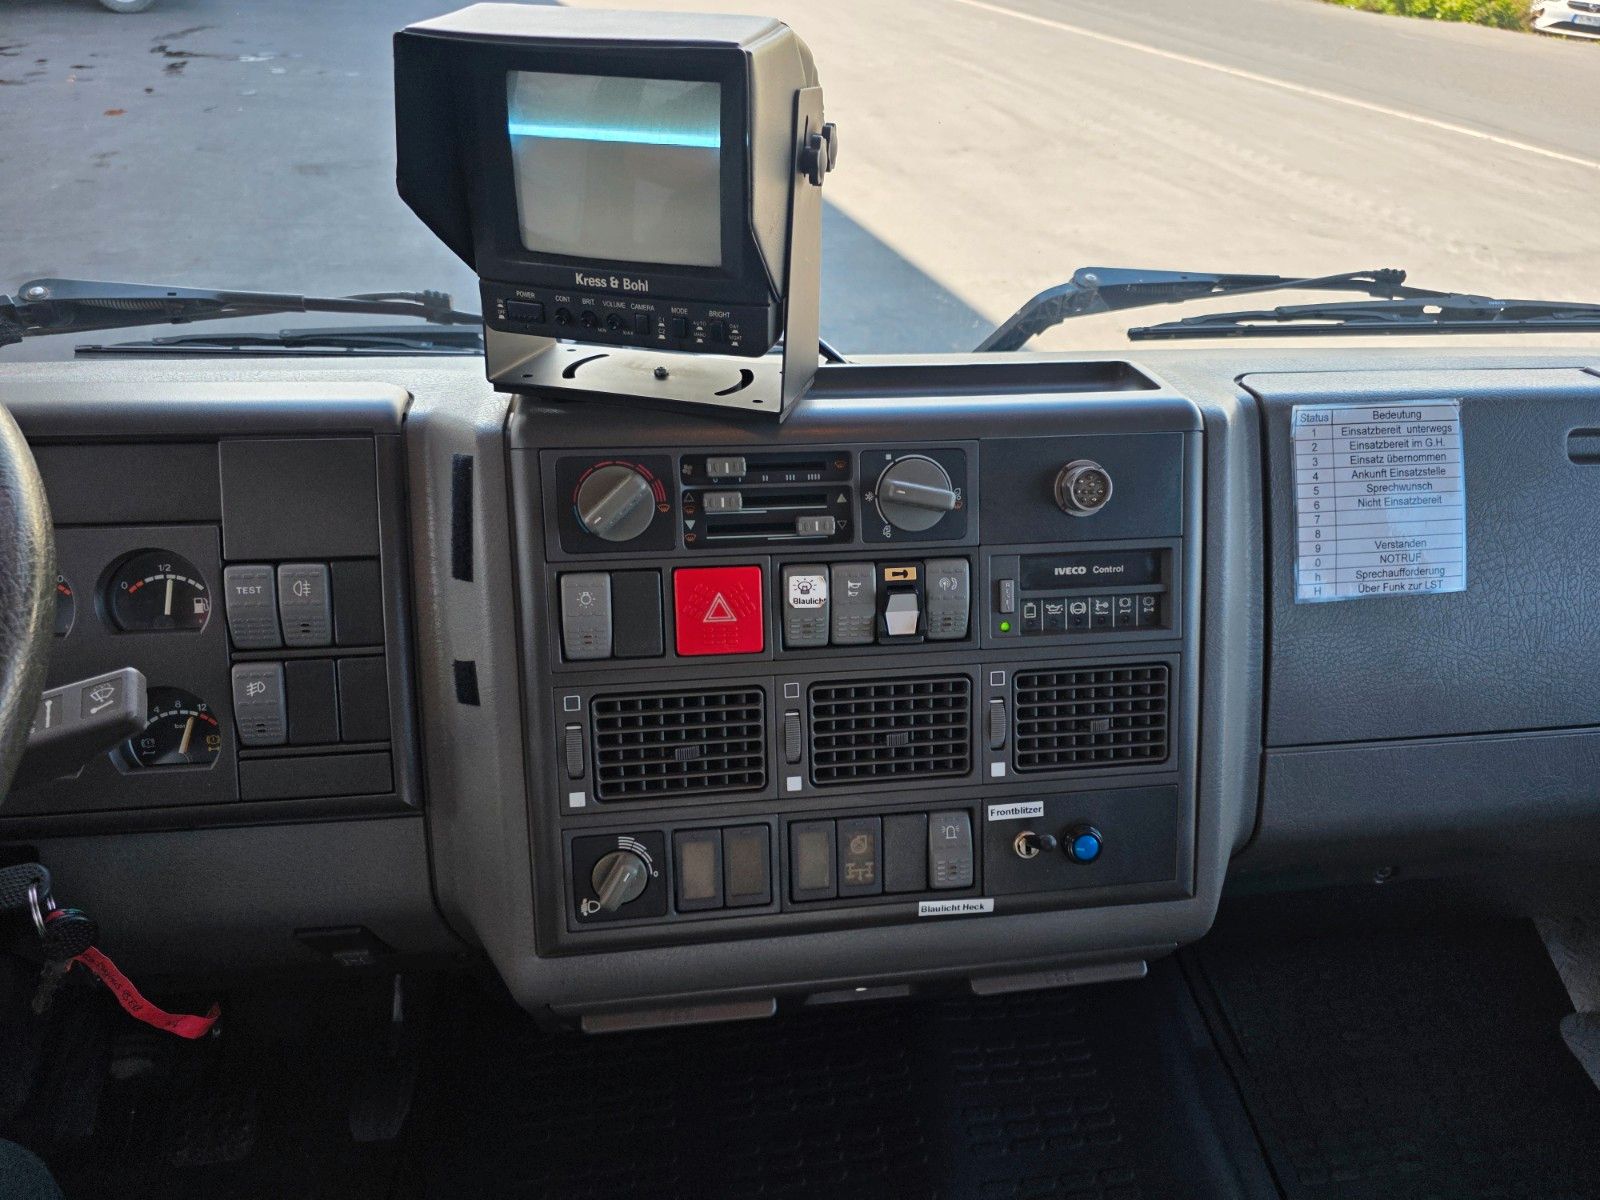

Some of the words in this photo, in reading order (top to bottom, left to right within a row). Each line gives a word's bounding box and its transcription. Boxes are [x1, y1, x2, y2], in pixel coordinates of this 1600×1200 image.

[575, 272, 607, 288] Kress
[609, 276, 619, 289] &
[622, 278, 649, 292] Bohl
[516, 290, 535, 299] POWER
[602, 300, 626, 309] VOLUME
[630, 303, 655, 312] CAMERA
[671, 307, 688, 315] MODE
[708, 310, 731, 319] BRIGHT
[1300, 413, 1329, 423] Status
[1372, 410, 1422, 421] Bedeutung
[1311, 429, 1317, 437] 1
[1341, 426, 1402, 436] Einsatzbereit
[1406, 424, 1453, 435] unterwegs
[1311, 443, 1318, 452] 2
[1350, 440, 1409, 450] Einsatzbereit
[1411, 439, 1423, 447] im
[1425, 438, 1445, 447] G.H.
[1312, 458, 1318, 467] 3
[1350, 455, 1384, 465] Einsatz
[1387, 453, 1446, 463] übernommen
[1312, 472, 1319, 481] 4
[1351, 468, 1387, 479] Ankunft
[1390, 467, 1446, 478] Einsatzstelle
[1313, 486, 1319, 495] 5
[1366, 482, 1432, 493] Sprechwunsch
[1313, 501, 1320, 509] 6
[1357, 497, 1381, 508] Nicht
[1384, 495, 1442, 506] Einsatzbereit
[1314, 515, 1320, 524] 7
[1315, 530, 1321, 538] 8
[1315, 544, 1321, 553] 9
[1375, 539, 1427, 550] Verstanden
[1380, 553, 1422, 563] NOTRUF
[158, 563, 171, 572] 1/2
[1054, 566, 1087, 576] IVECO
[1092, 564, 1124, 574] Control
[1315, 573, 1321, 582] h
[1355, 566, 1445, 580] Sprechaufforderung
[236, 586, 262, 595] TEST
[1314, 586, 1321, 595] H
[1358, 583, 1380, 593] Über
[1383, 581, 1405, 592] Funk
[1408, 583, 1422, 591] zur
[1425, 580, 1443, 589] LST
[174, 700, 181, 708] 8
[198, 703, 208, 711] 12
[990, 806, 1042, 816] Frontblitzer
[920, 902, 960, 913] Blaulicht
[962, 902, 984, 911] Heck
